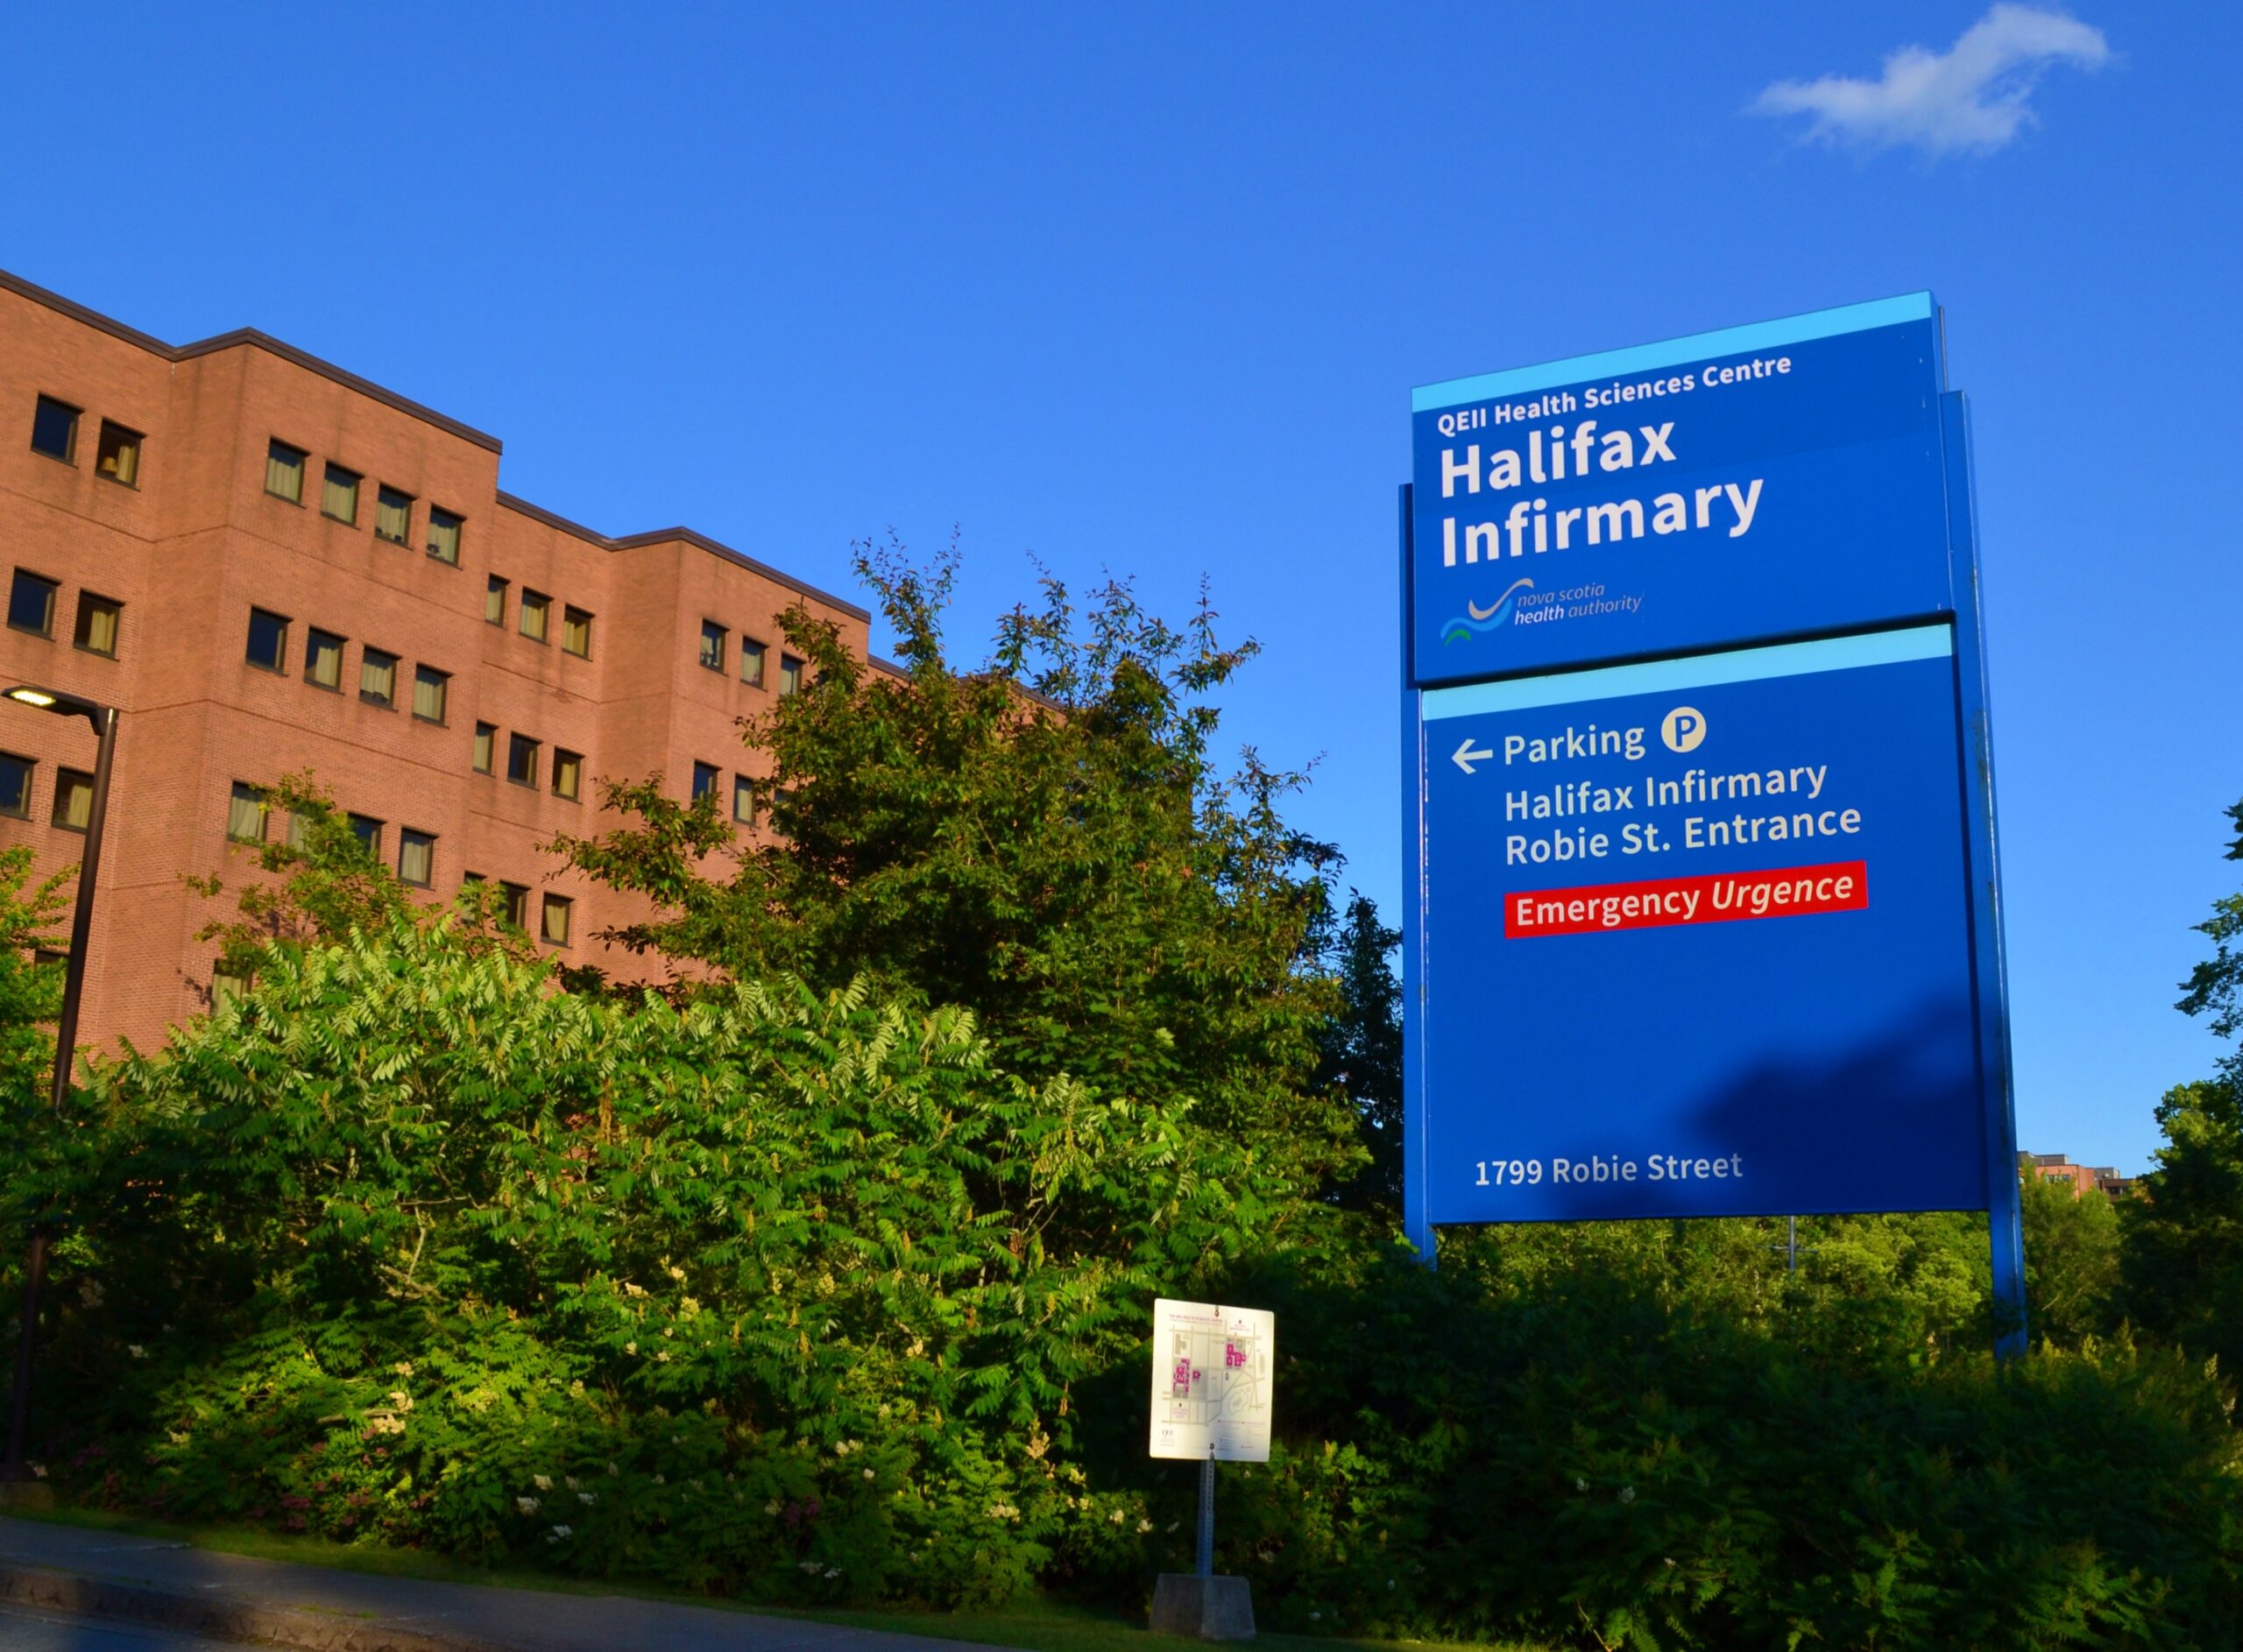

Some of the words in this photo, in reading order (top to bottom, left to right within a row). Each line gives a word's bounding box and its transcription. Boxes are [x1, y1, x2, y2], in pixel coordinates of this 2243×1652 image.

[1438, 407, 1488, 438] QEII
[1495, 392, 1576, 425] Health
[1584, 373, 1696, 410] Sciences
[1702, 357, 1793, 388] Centre
[1441, 420, 1677, 498] Halifax
[1443, 478, 1765, 568] Infirmary
[1514, 604, 1565, 625] health
[1567, 595, 1643, 618] authority
[1518, 592, 1554, 608] nova
[1559, 582, 1605, 602] scotia
[1504, 724, 1646, 766] Parking
[1505, 777, 1635, 822] Halifax
[1646, 764, 1828, 810] Infirmary
[1505, 823, 1610, 865] Robie
[1621, 822, 1671, 854] St.
[1685, 808, 1862, 849] Entrance
[1516, 889, 1702, 927] Emergency
[1711, 876, 1854, 914] Urgence
[1475, 1159, 1543, 1186] 1799
[1552, 1154, 1638, 1183] Robie
[1647, 1152, 1744, 1180] Street
